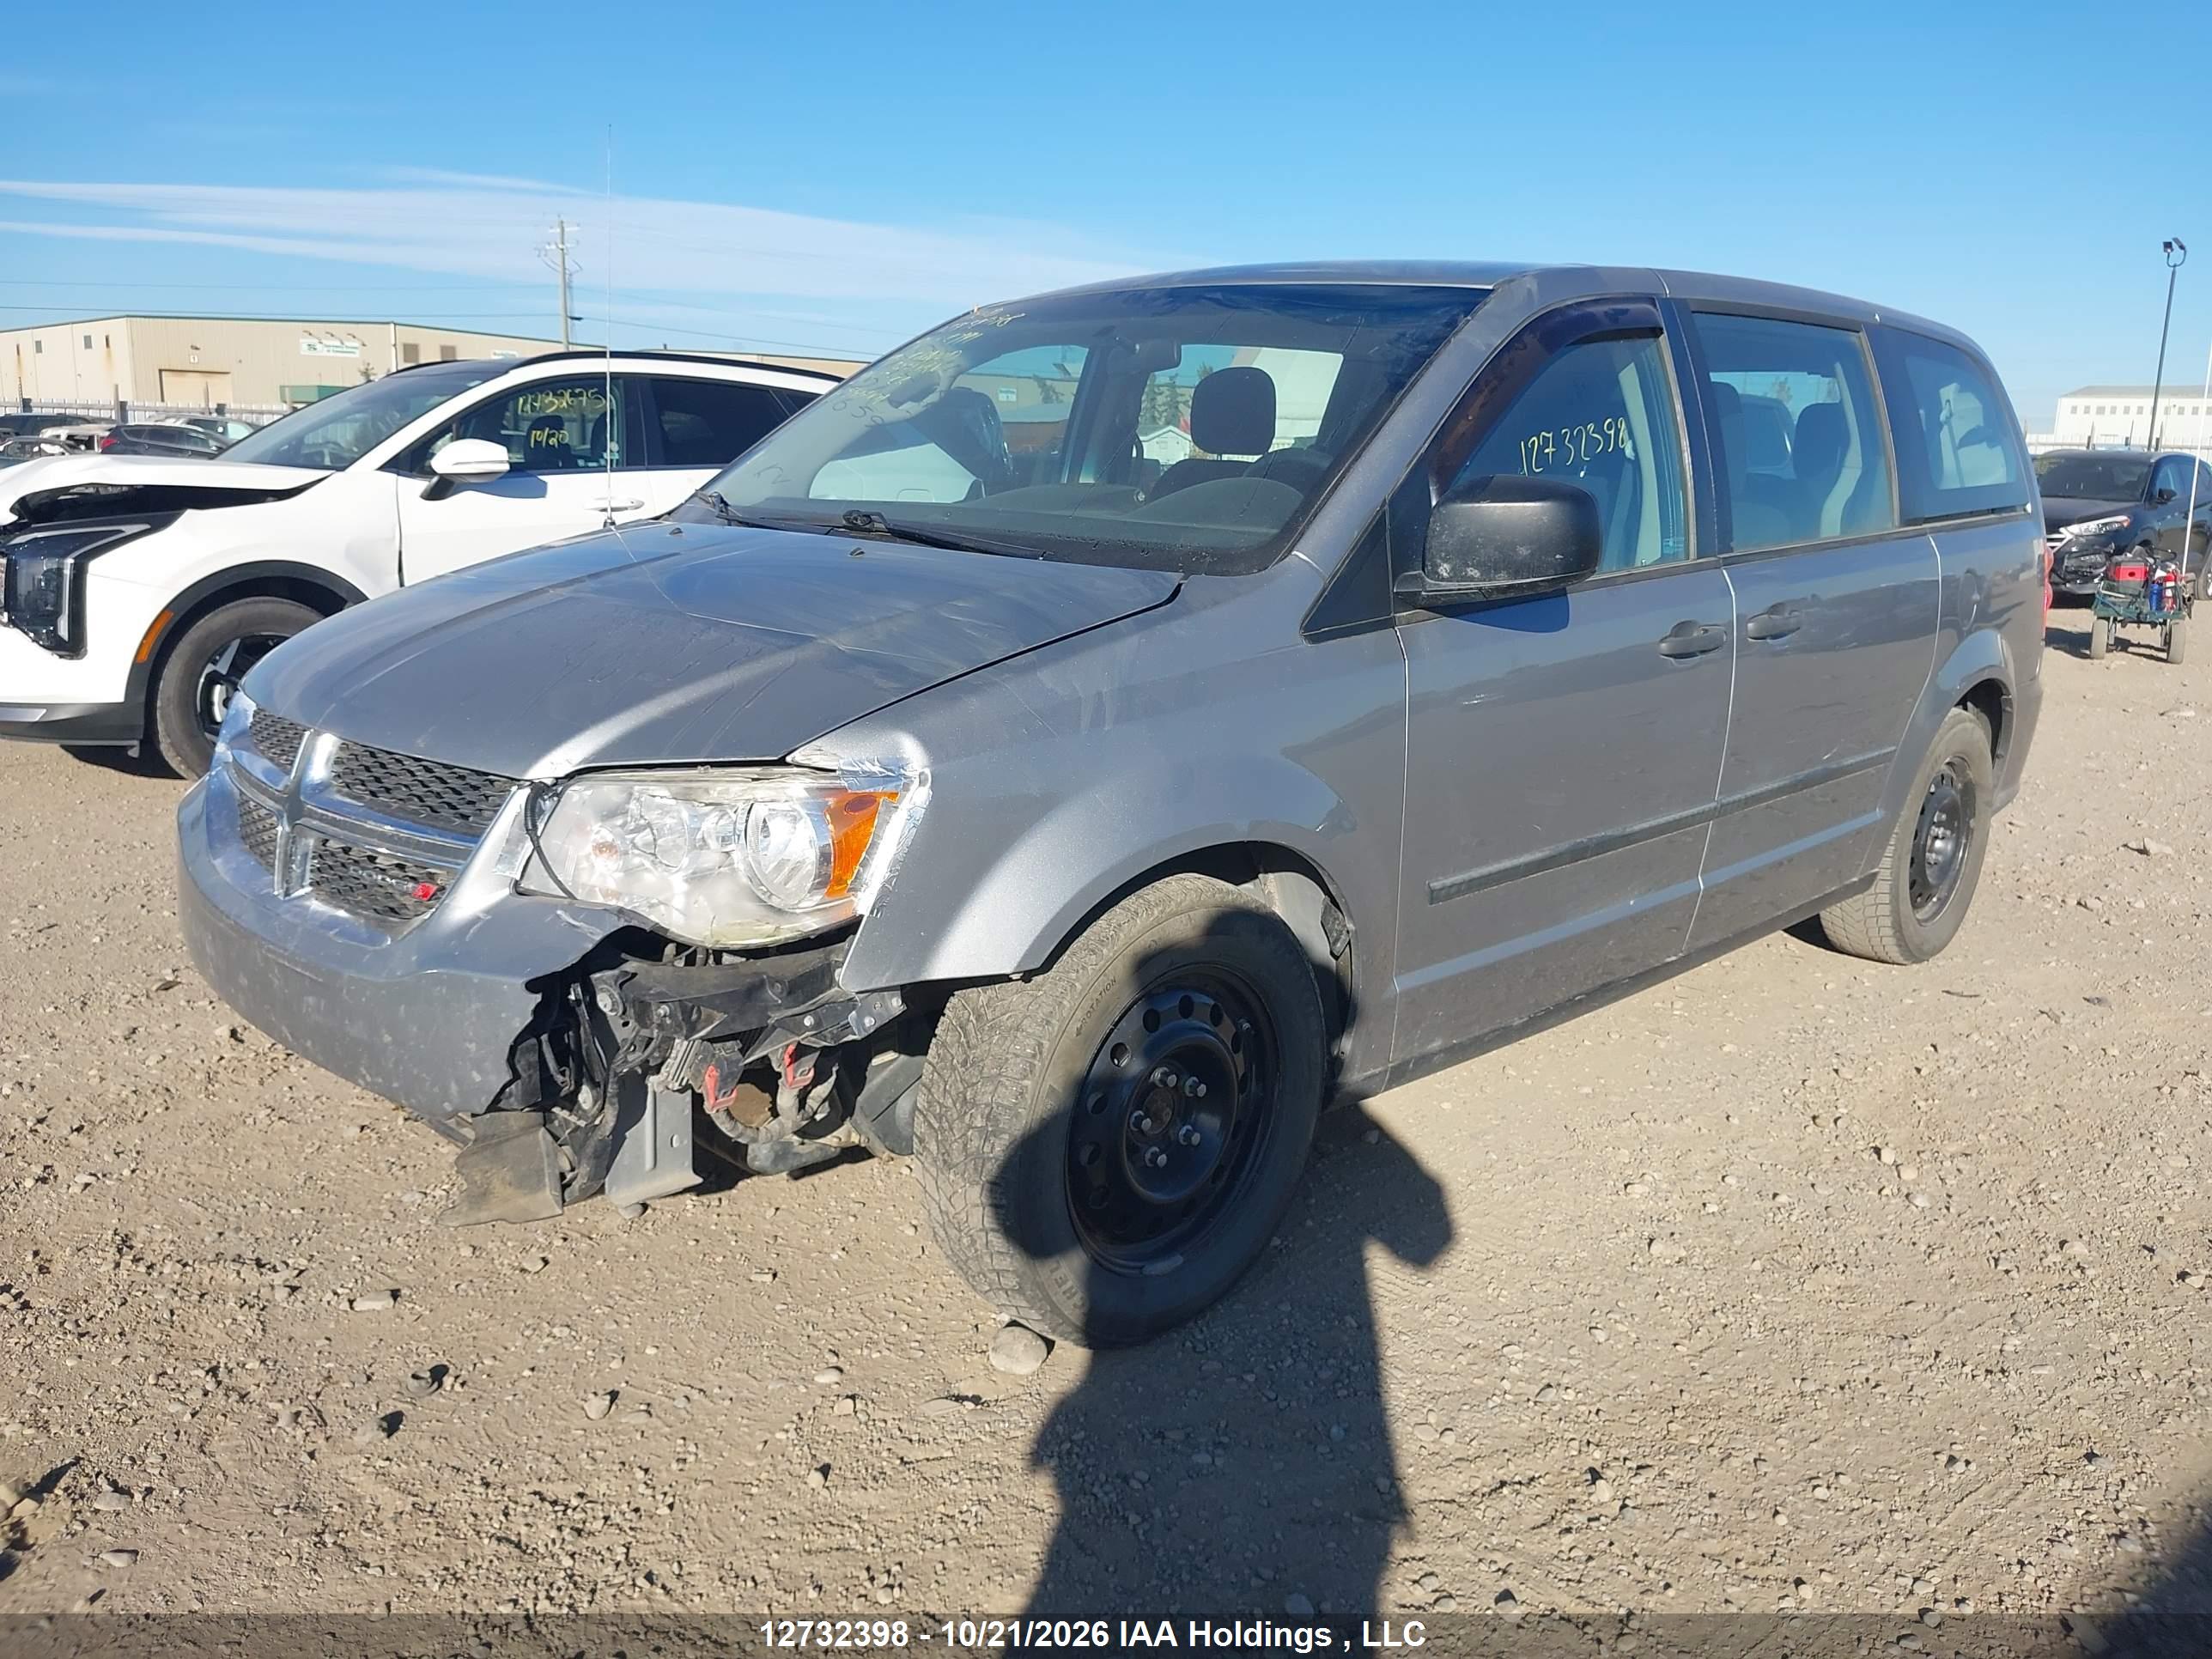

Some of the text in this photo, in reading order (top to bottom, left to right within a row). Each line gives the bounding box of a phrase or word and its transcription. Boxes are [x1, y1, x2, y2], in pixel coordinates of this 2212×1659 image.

[530, 427, 568, 449] 10/20
[1520, 417, 1627, 477] 12732398
[1079, 975, 1118, 1027] ROTATION
